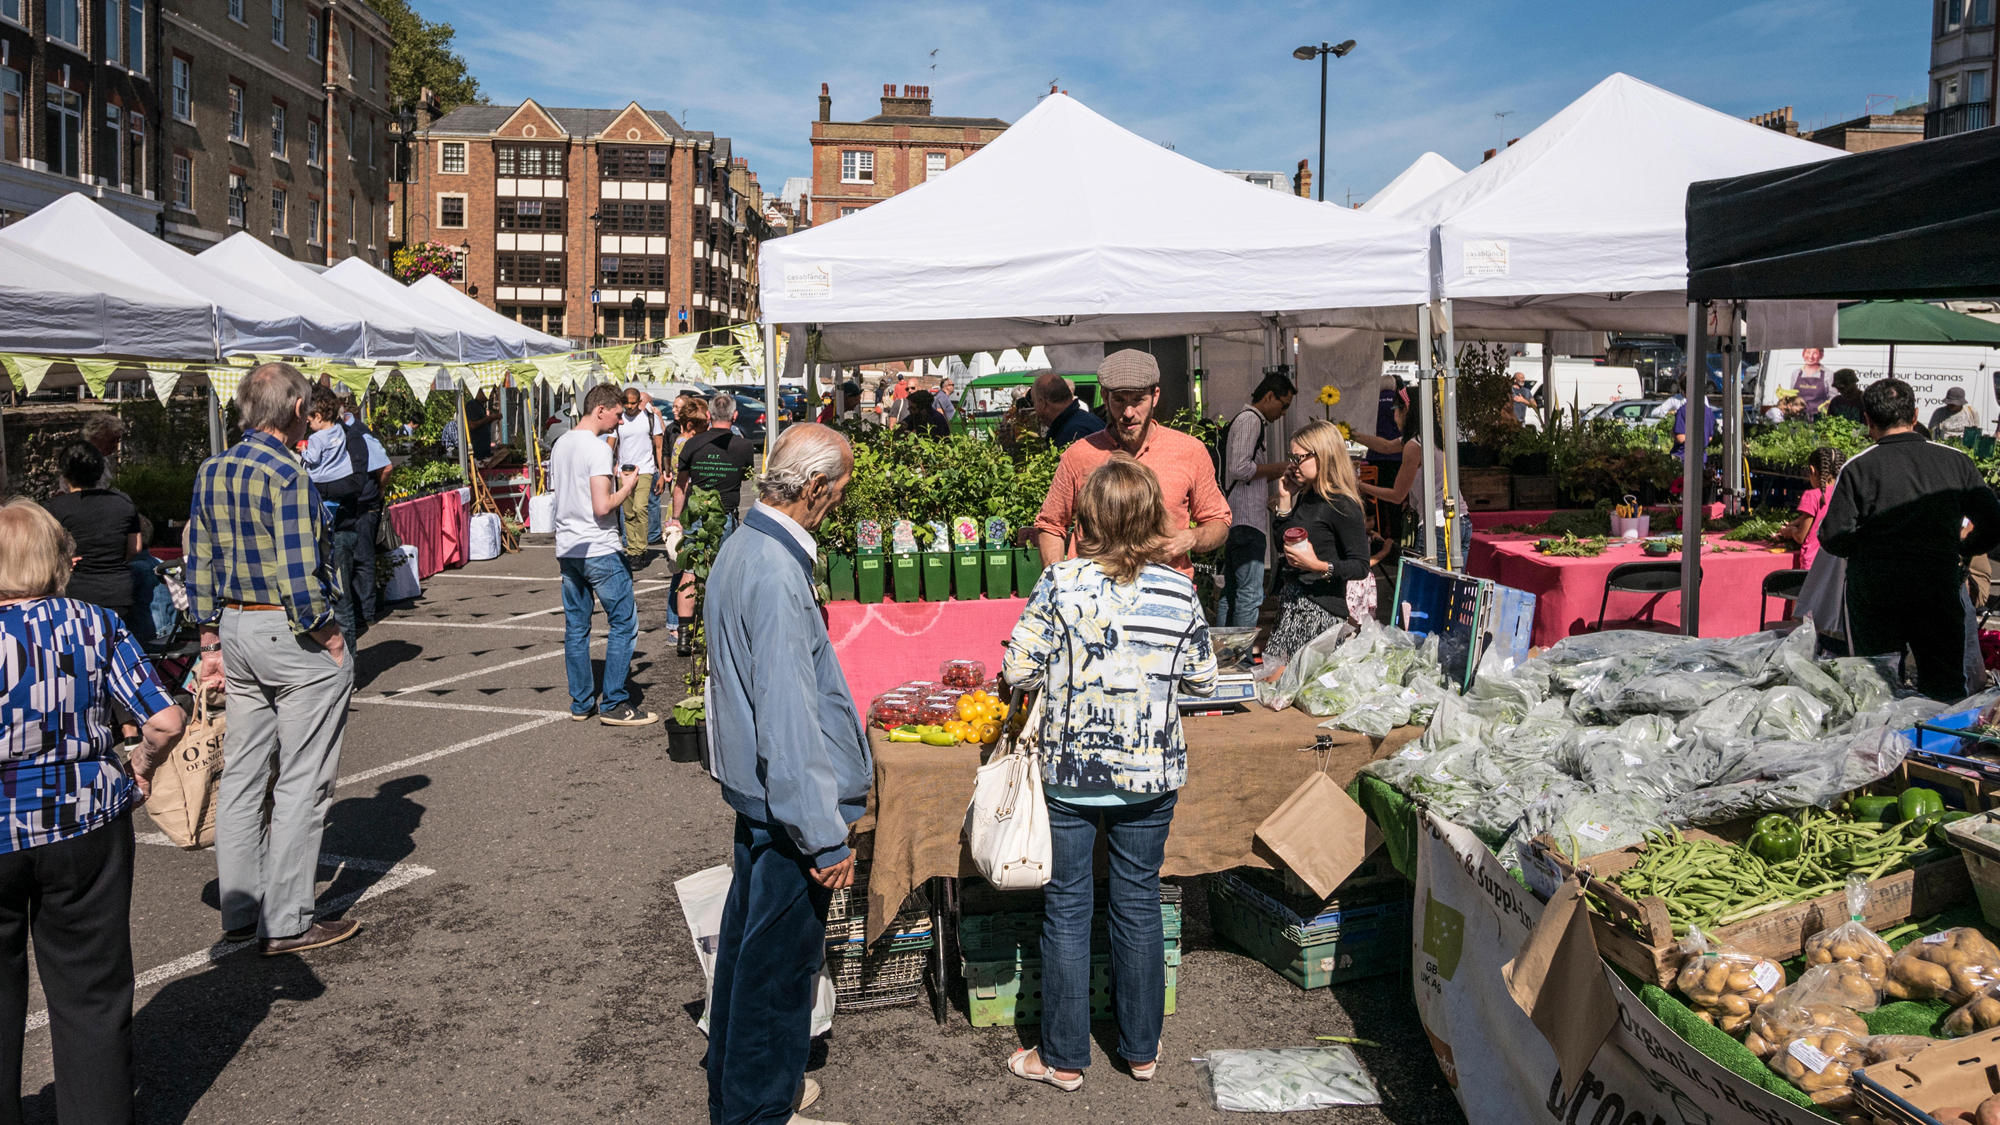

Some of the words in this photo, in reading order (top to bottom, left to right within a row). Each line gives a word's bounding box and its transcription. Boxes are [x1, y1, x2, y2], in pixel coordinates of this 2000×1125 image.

[1854, 369, 1884, 379] Prefer
[1914, 371, 1964, 382] bananas
[1914, 384, 1933, 393] and
[186, 761, 200, 772] OF
[1464, 853, 1476, 881] &
[1477, 865, 1537, 932] Supplin
[1420, 971, 1430, 986] UK
[1431, 979, 1442, 994] Ag
